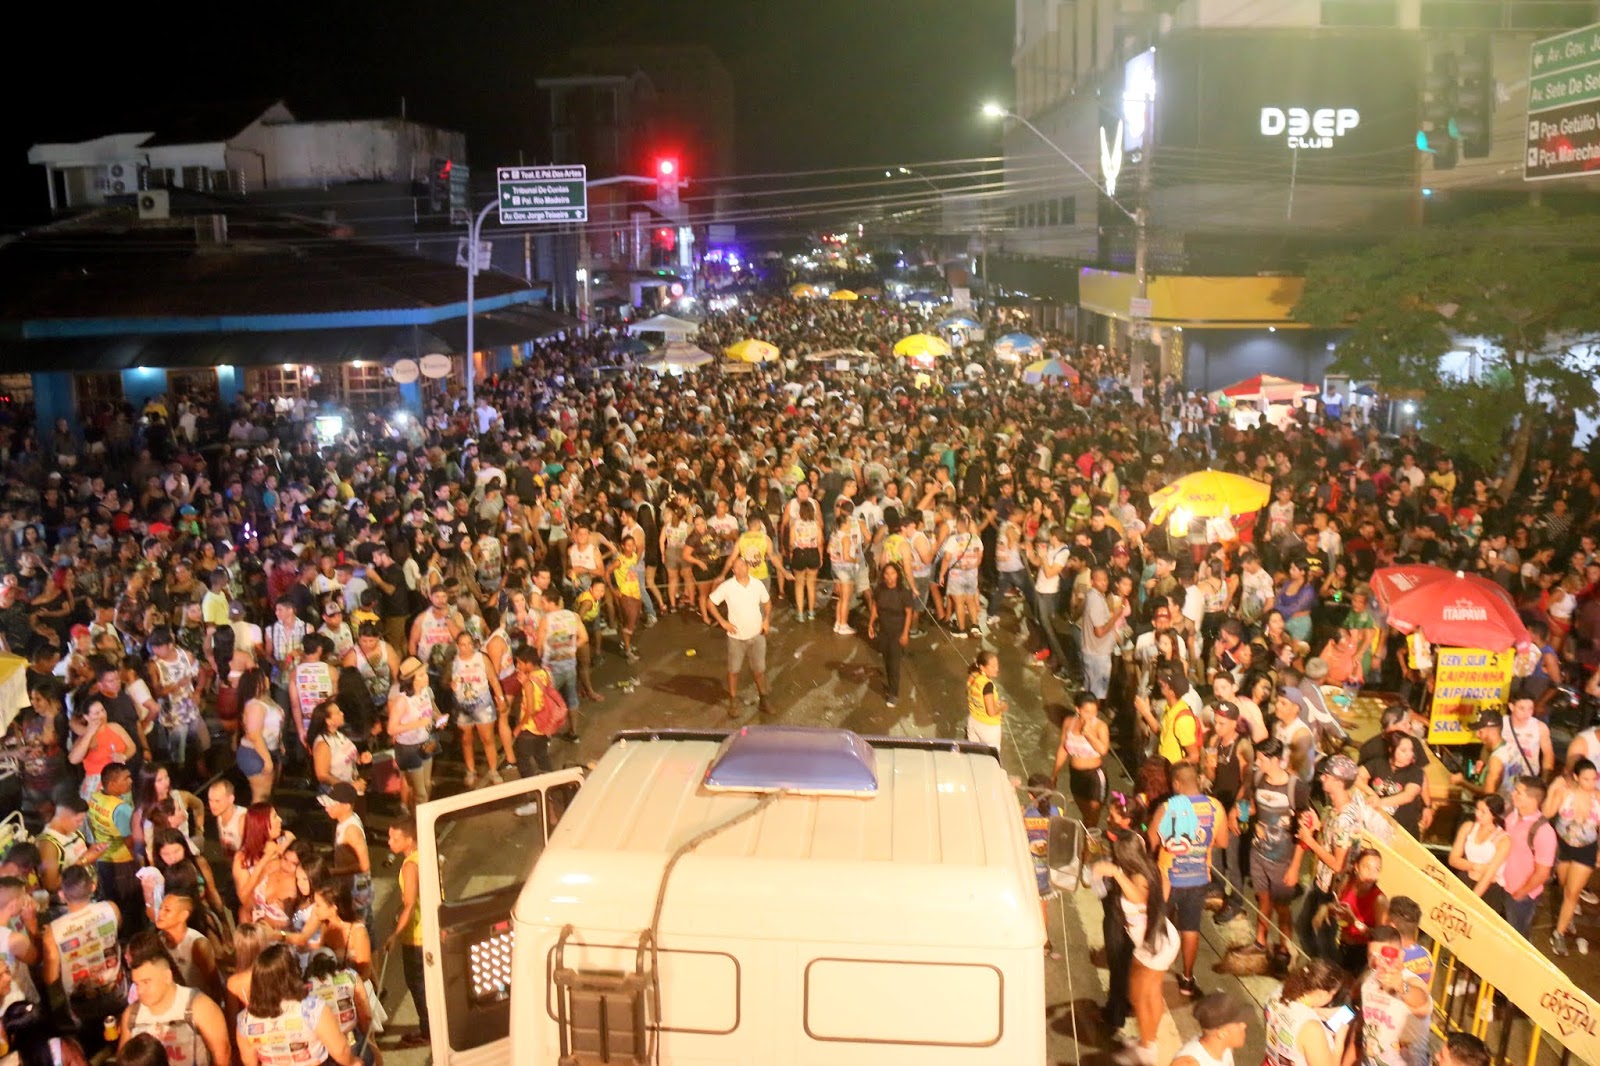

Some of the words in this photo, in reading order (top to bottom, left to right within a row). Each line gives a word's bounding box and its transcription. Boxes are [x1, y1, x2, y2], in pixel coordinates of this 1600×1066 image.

[1565, 41, 1586, 58] Gov.
[1546, 82, 1566, 99] Sete
[1568, 77, 1582, 95] De
[1560, 113, 1595, 135] Getúlio
[1287, 136, 1333, 148] CLUB
[1442, 607, 1488, 621] ITAIPAVA
[1439, 670, 1505, 683] CAIPIRINHA
[1436, 686, 1502, 699] CAIPIROSCA
[1433, 720, 1462, 733] SKOL
[1430, 906, 1472, 941] CRYSTAL
[1540, 992, 1598, 1038] CRYSTAL
